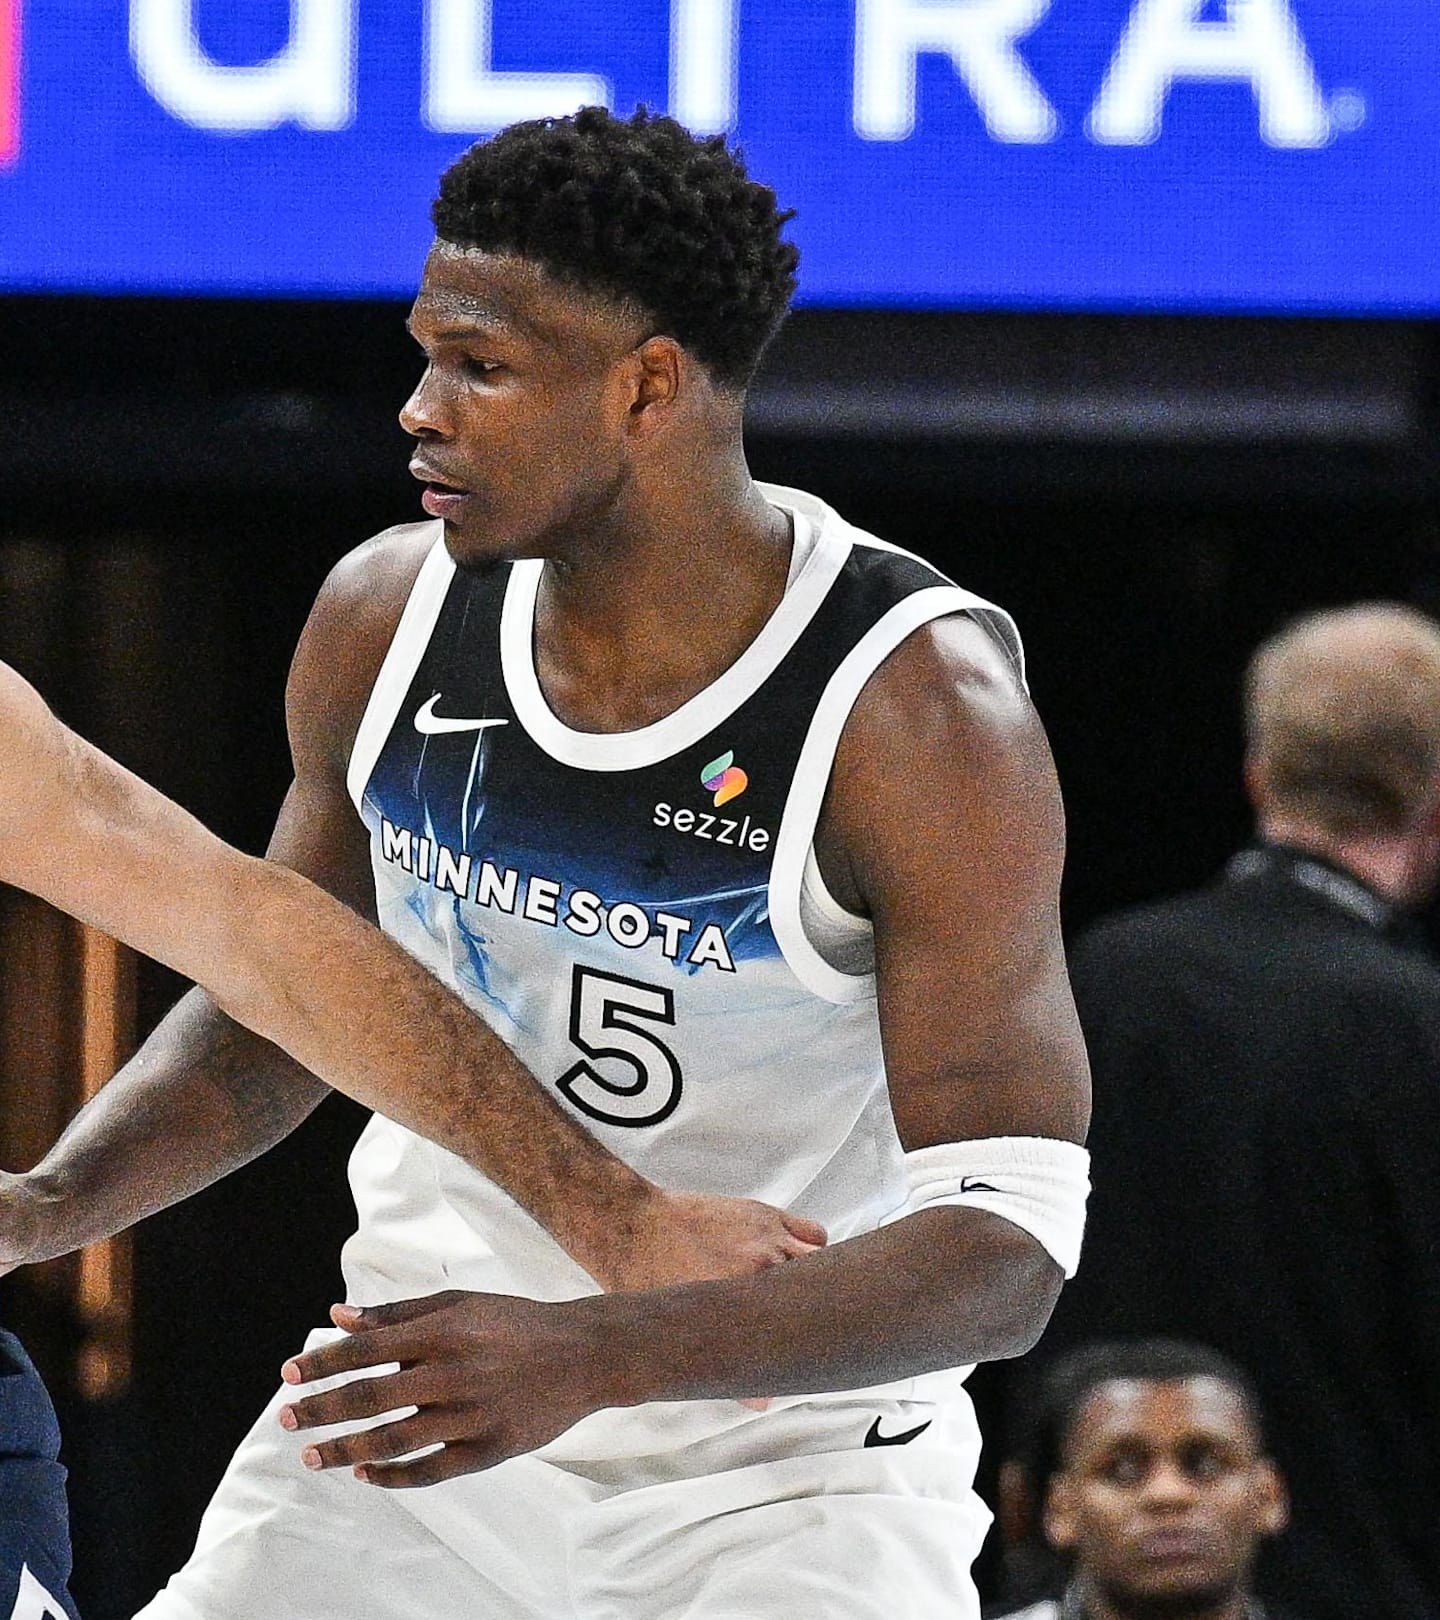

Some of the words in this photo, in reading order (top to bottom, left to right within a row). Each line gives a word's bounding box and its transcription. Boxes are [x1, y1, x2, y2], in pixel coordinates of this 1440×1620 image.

[380, 818, 737, 973] MINNESOTA
[653, 801, 770, 852] sezzle
[556, 963, 683, 1128] 5
